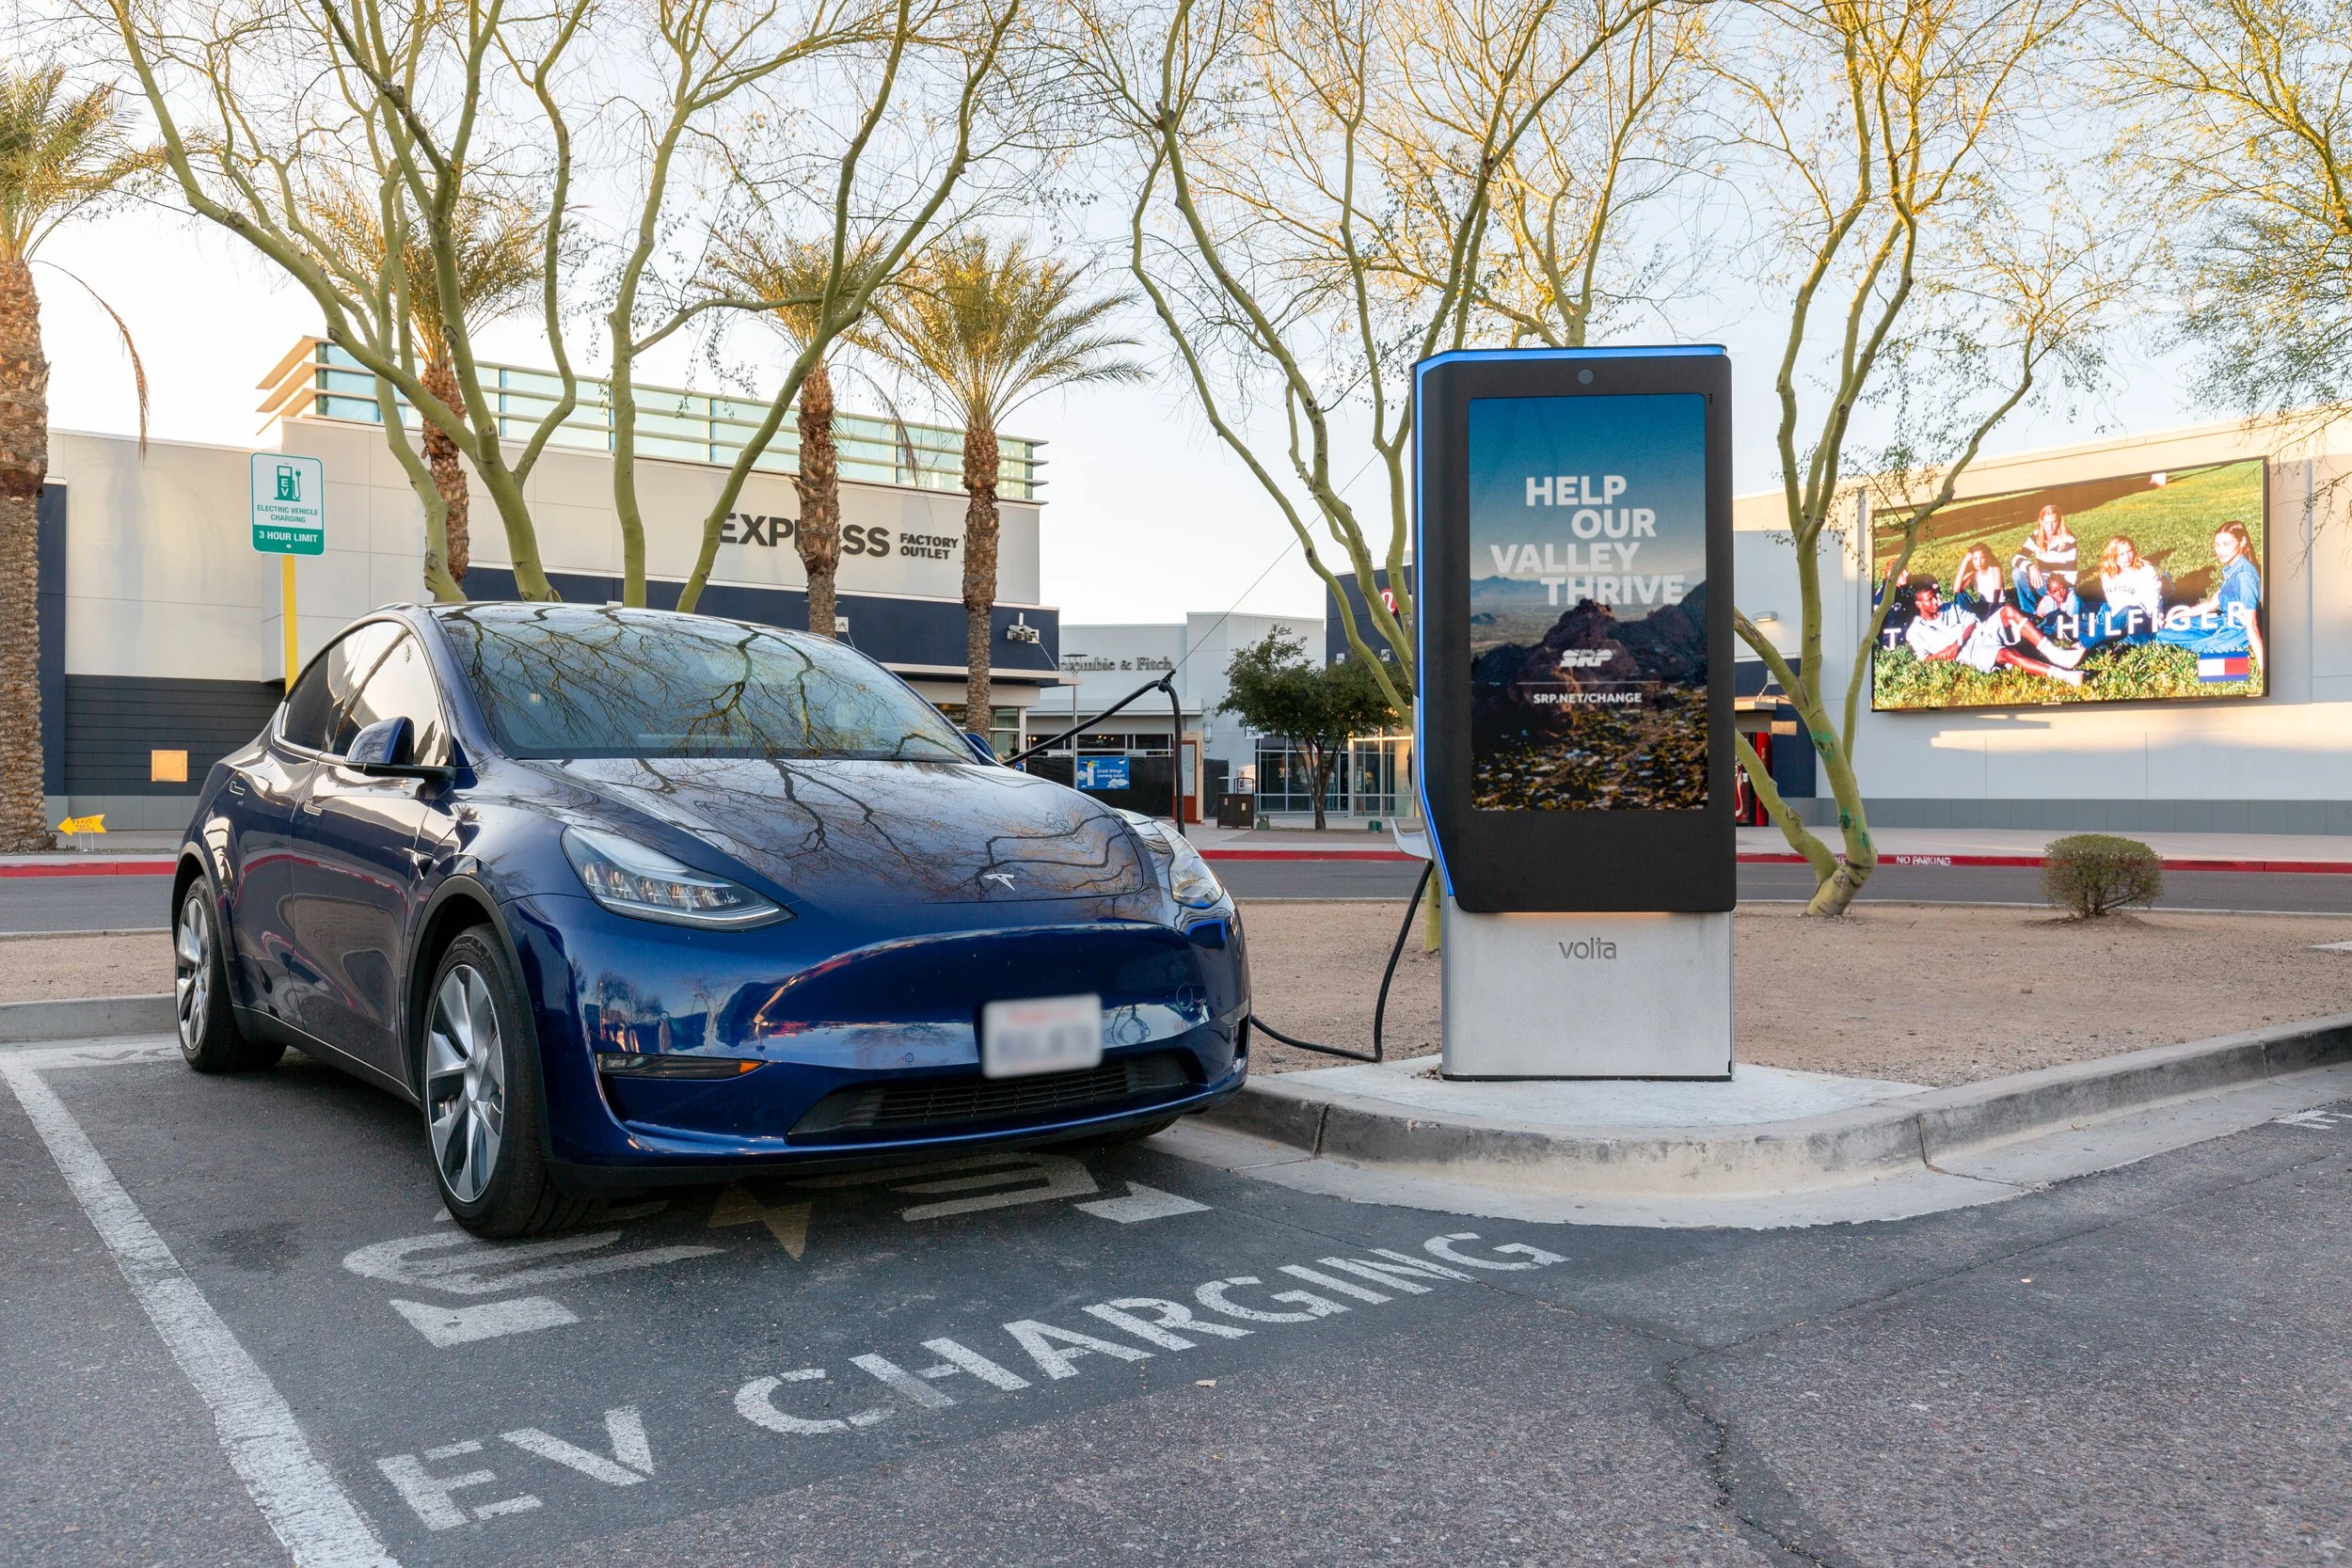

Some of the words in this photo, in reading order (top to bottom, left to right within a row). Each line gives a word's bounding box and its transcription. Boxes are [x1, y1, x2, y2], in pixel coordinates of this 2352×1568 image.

[1526, 475, 1627, 506] HELP
[257, 504, 290, 514] ELECTRIC
[291, 507, 319, 516] VEHICLE
[270, 514, 307, 524] CHARGING
[1571, 508, 1657, 539] OUR
[259, 530, 265, 539] 3
[266, 531, 292, 541] HOUR
[294, 532, 318, 543] LIMIT
[719, 513, 890, 558] EXPSS
[899, 532, 960, 548] FACTORY
[899, 546, 950, 560] OUTLET
[1490, 542, 1641, 573] VALLEY
[1540, 574, 1685, 606] THRIVE
[2057, 601, 2248, 640] HILFIGER
[1059, 657, 1116, 672] crombie
[1120, 658, 1132, 671] &
[1136, 656, 1173, 671] Fitch
[1560, 649, 1613, 667] SRP
[1534, 692, 1642, 704] SRP.NET/CHANGE
[1896, 856, 1911, 864] NO
[1912, 856, 1951, 866] PARKING
[1558, 937, 1617, 960] volta
[377, 1405, 655, 1531] EV
[734, 1232, 1569, 1435] CHARGING
